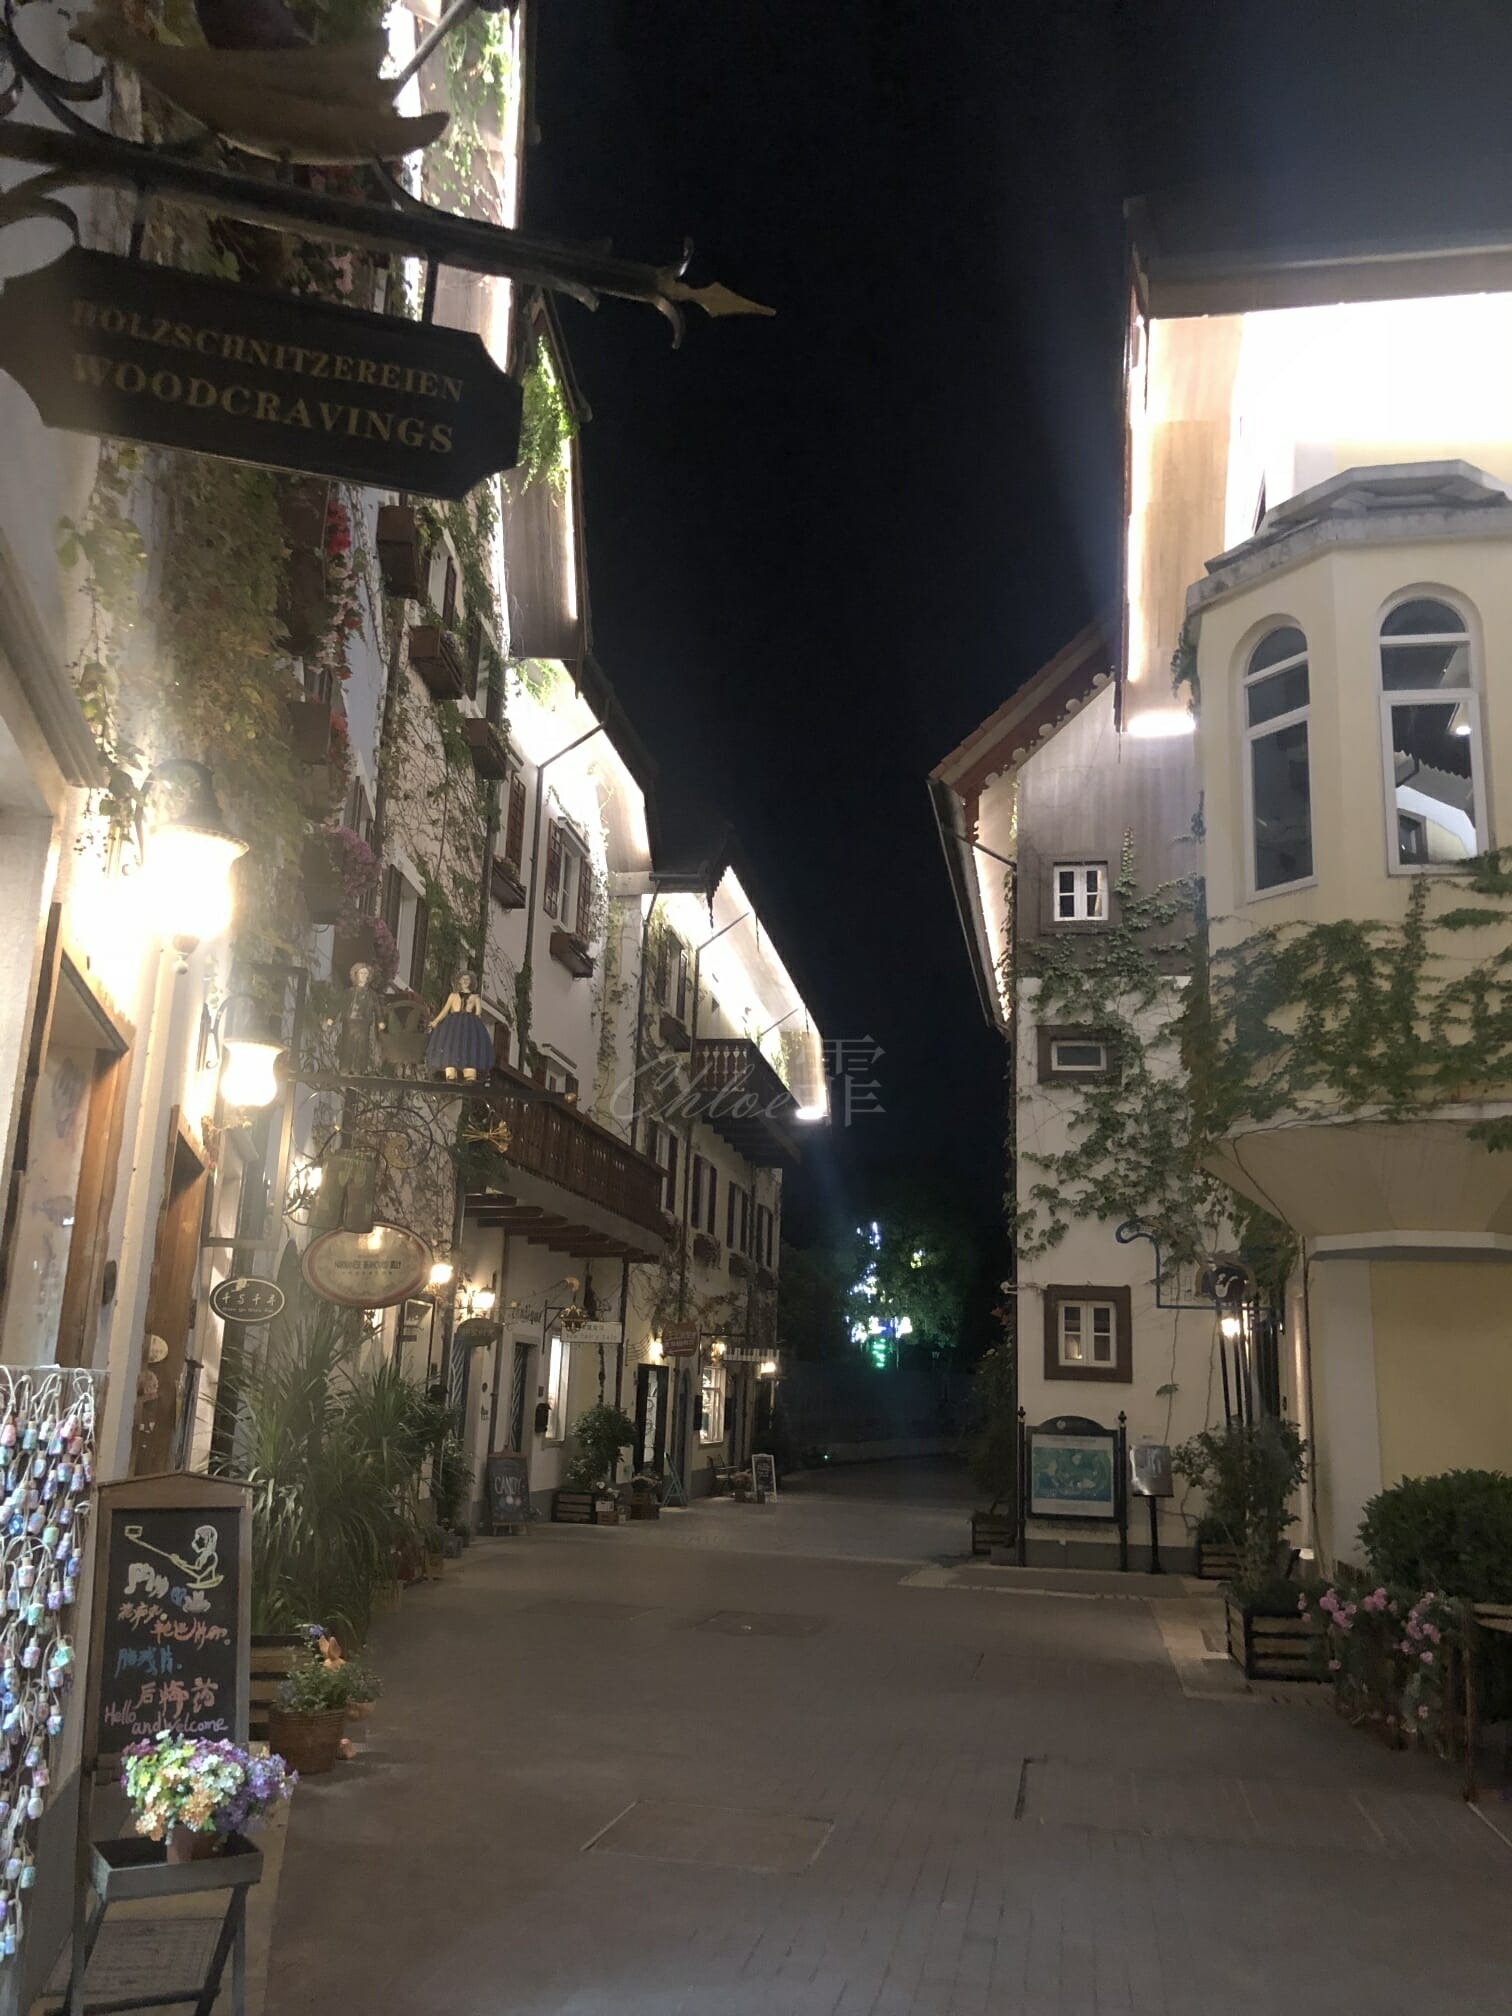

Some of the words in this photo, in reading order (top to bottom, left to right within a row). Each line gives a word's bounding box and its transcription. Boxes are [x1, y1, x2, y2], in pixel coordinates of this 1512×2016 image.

[72, 302, 464, 402] HOLZSCHNITZEREIEN
[72, 354, 454, 453] WOODCRAVINGS
[105, 1700, 136, 1726] Hello
[133, 1711, 161, 1735] and
[163, 1712, 228, 1733] welcome
